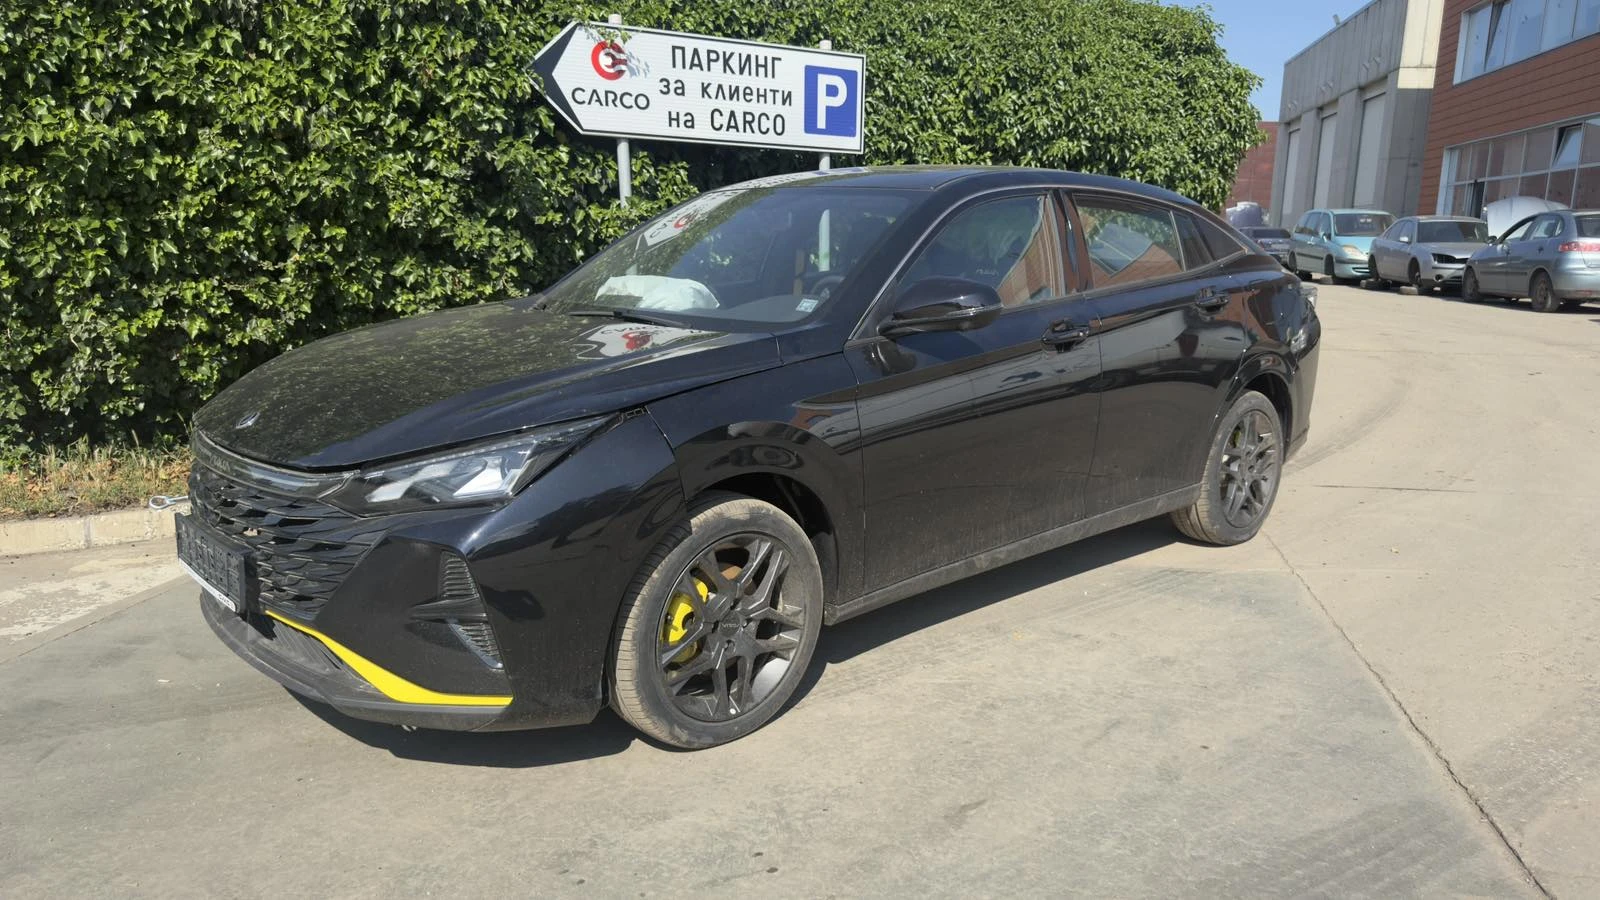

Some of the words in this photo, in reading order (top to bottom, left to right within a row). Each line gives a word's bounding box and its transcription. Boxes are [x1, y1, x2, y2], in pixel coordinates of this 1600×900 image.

[671, 45, 783, 79] ПАРКИНГ
[571, 87, 650, 111] CARCO
[659, 77, 686, 97] за
[701, 82, 793, 107] клиенти
[816, 73, 848, 130] P
[668, 110, 695, 129] на
[710, 108, 786, 137] CARCO
